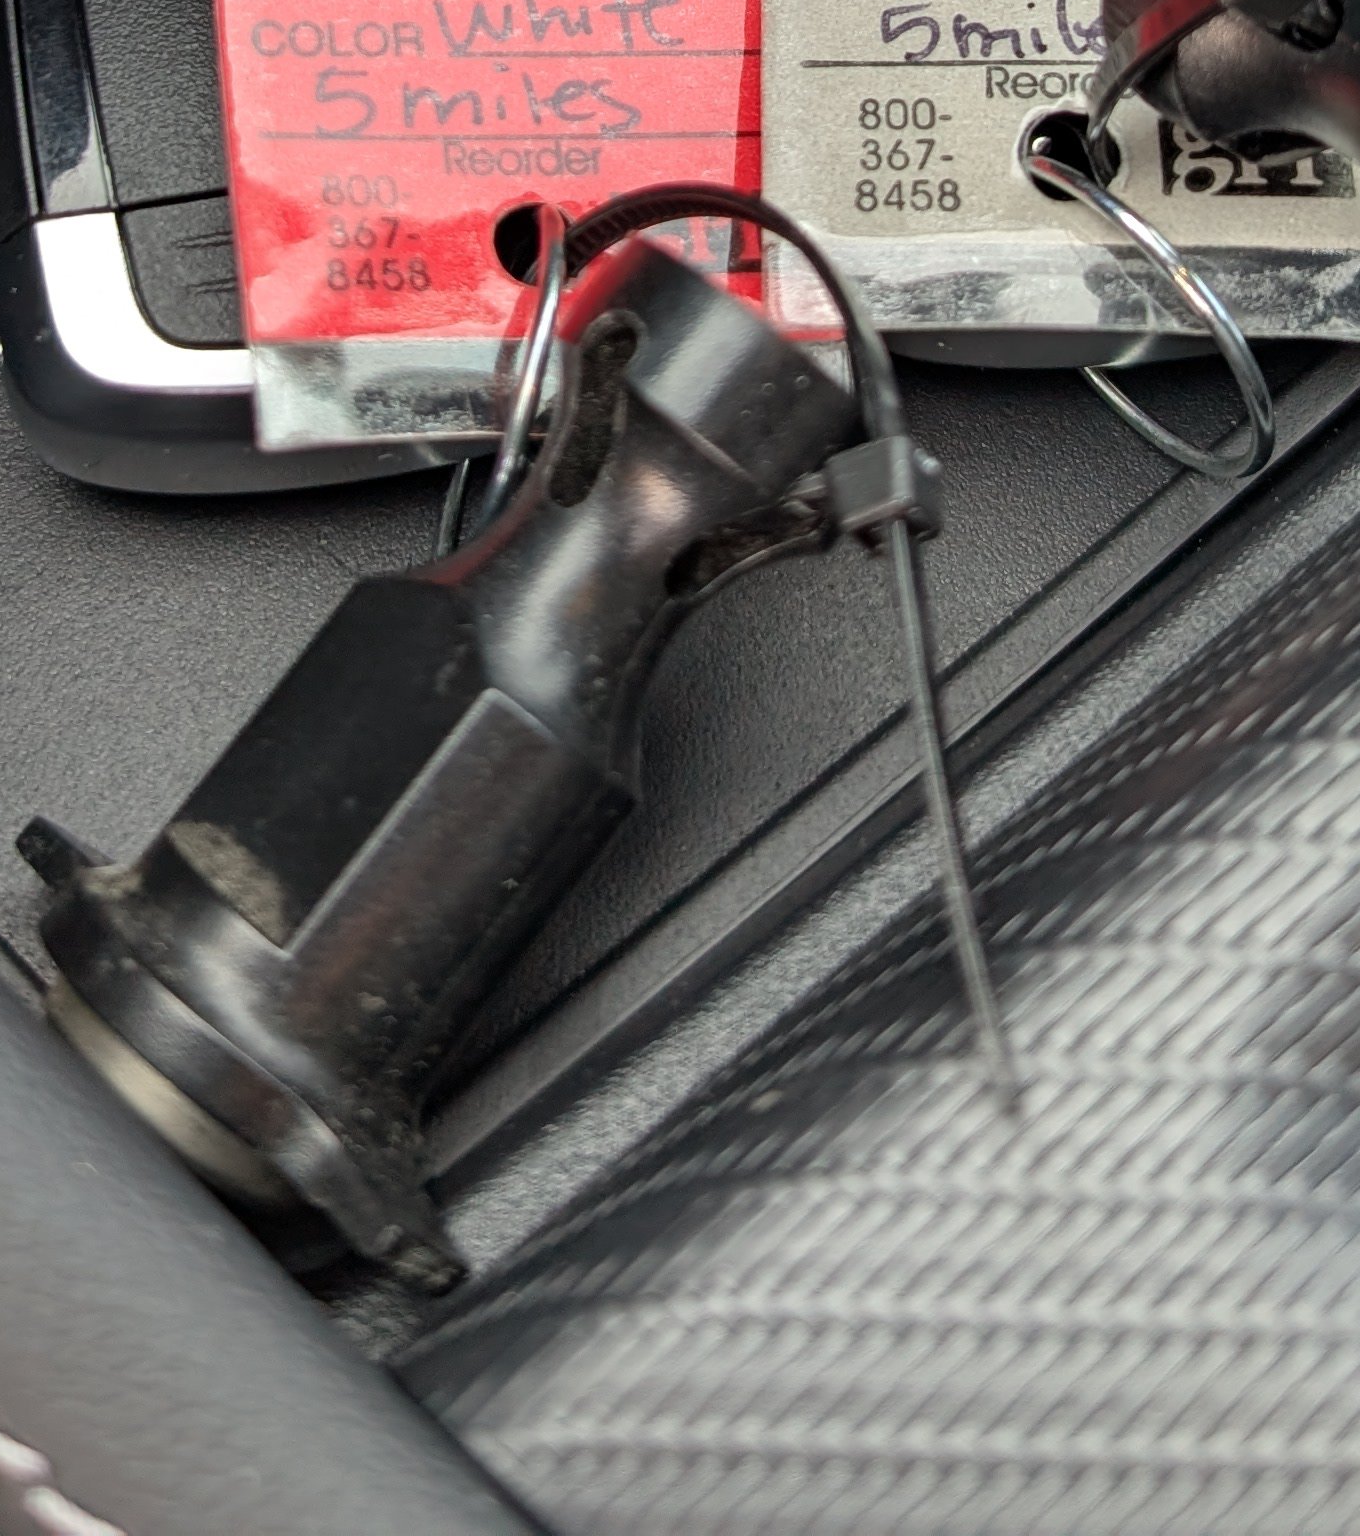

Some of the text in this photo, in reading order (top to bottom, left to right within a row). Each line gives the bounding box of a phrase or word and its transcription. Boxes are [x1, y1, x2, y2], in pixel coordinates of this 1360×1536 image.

[251, 21, 425, 58] COLOR
[986, 66, 1106, 99] Reor
[315, 64, 642, 139] 5 miles
[858, 98, 952, 130] 800-
[443, 139, 602, 178] Reorder
[860, 138, 954, 170] 367-
[322, 174, 413, 207] 800-
[854, 178, 962, 212] 8458
[328, 215, 420, 249] 367-
[327, 257, 432, 291] 8458
